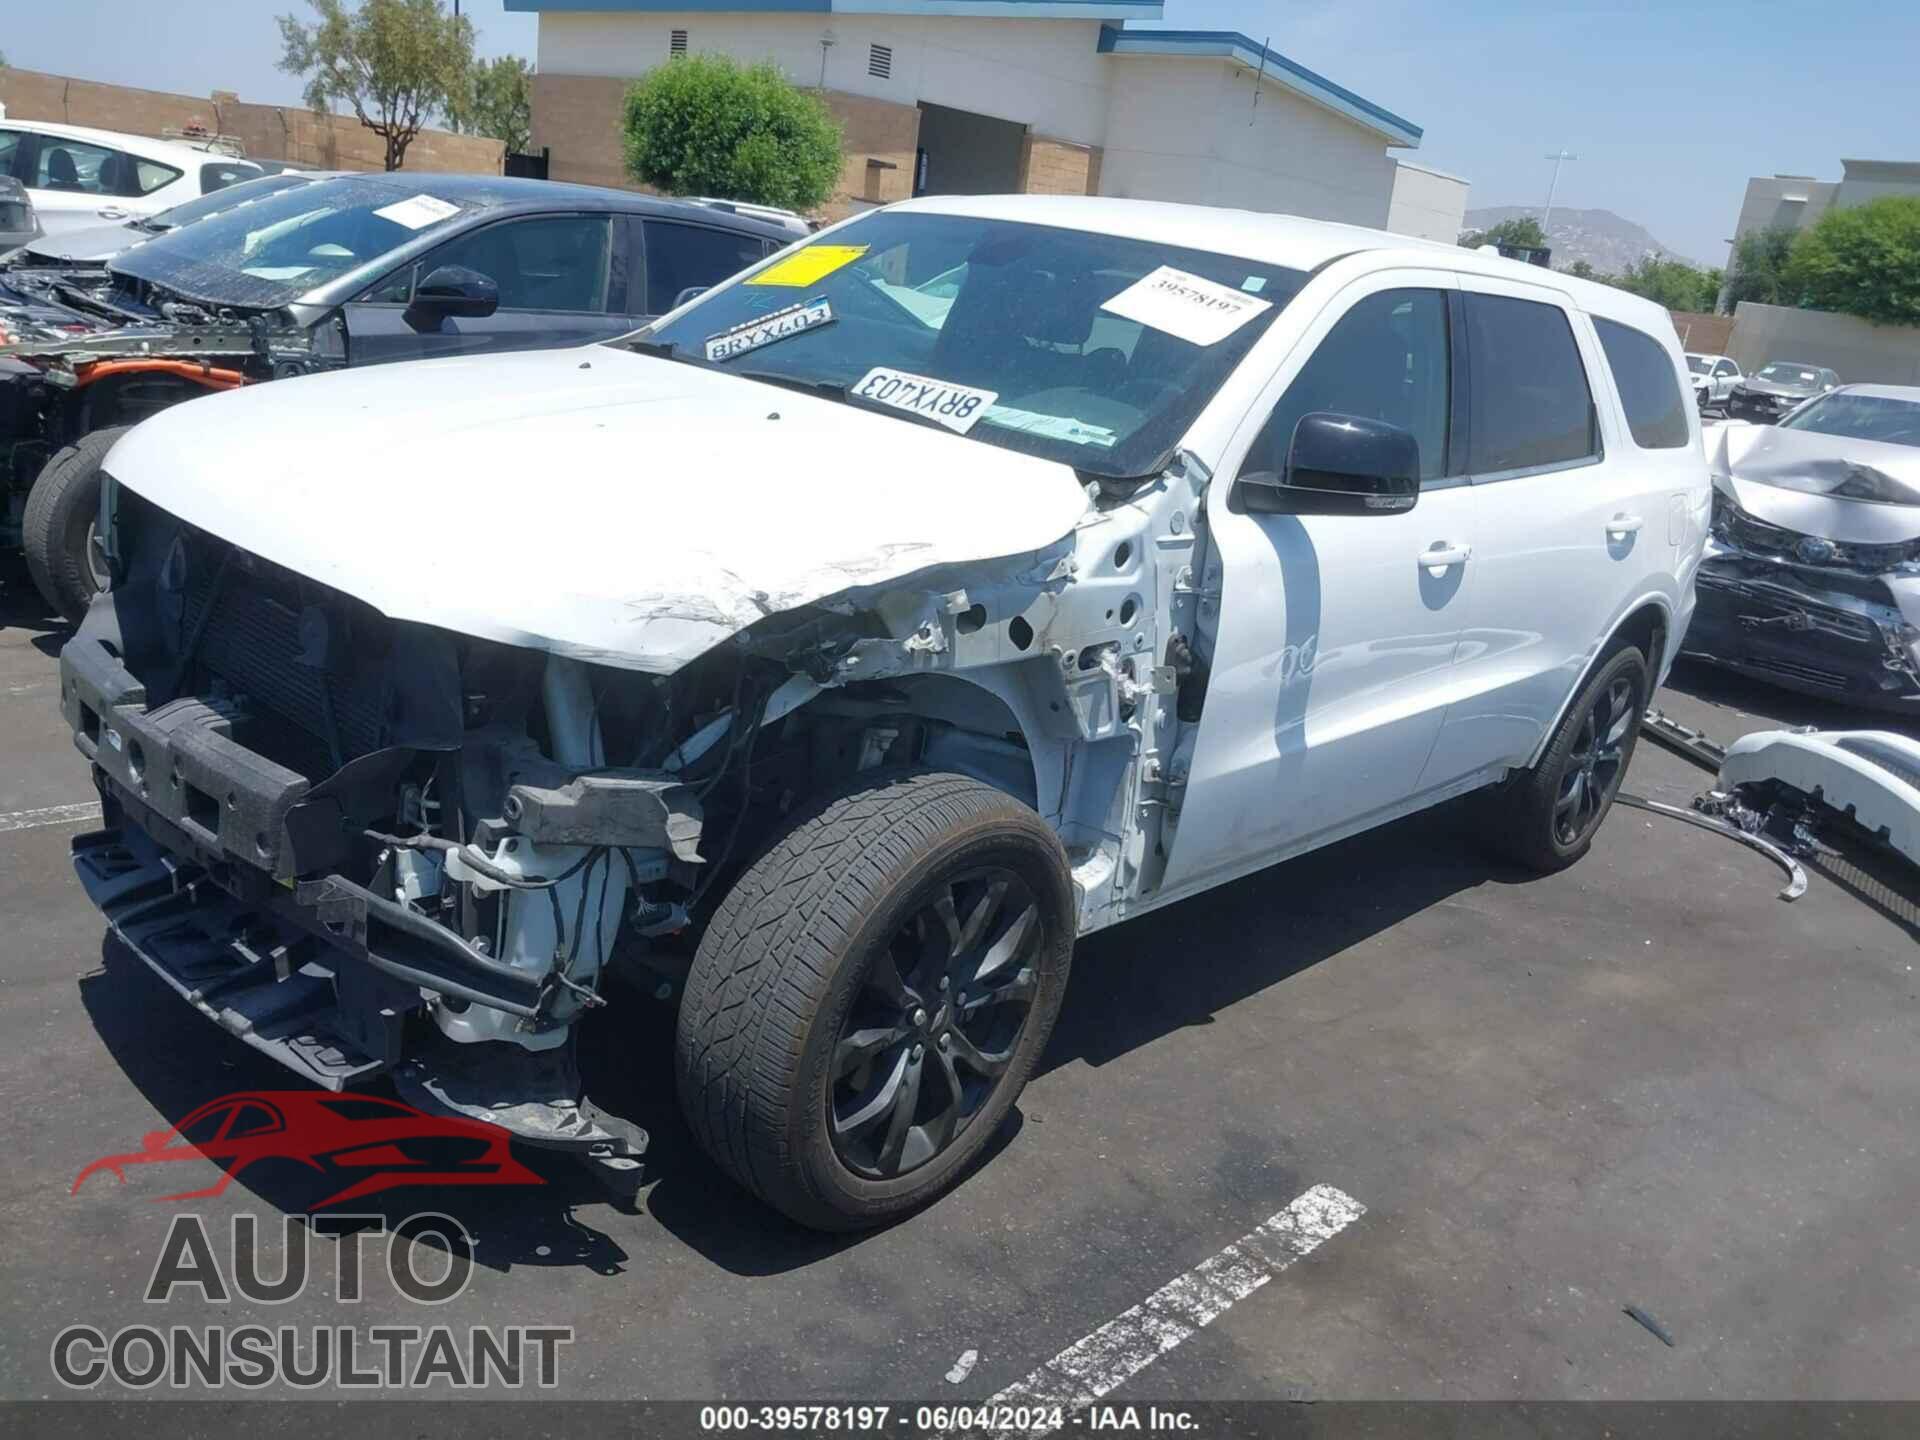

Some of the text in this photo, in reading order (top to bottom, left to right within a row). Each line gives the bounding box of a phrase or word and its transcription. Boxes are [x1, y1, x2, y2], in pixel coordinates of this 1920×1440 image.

[1151, 279, 1241, 315] 39578197
[711, 307, 827, 359] 8RYX403
[861, 374, 983, 419] 8RYX403
